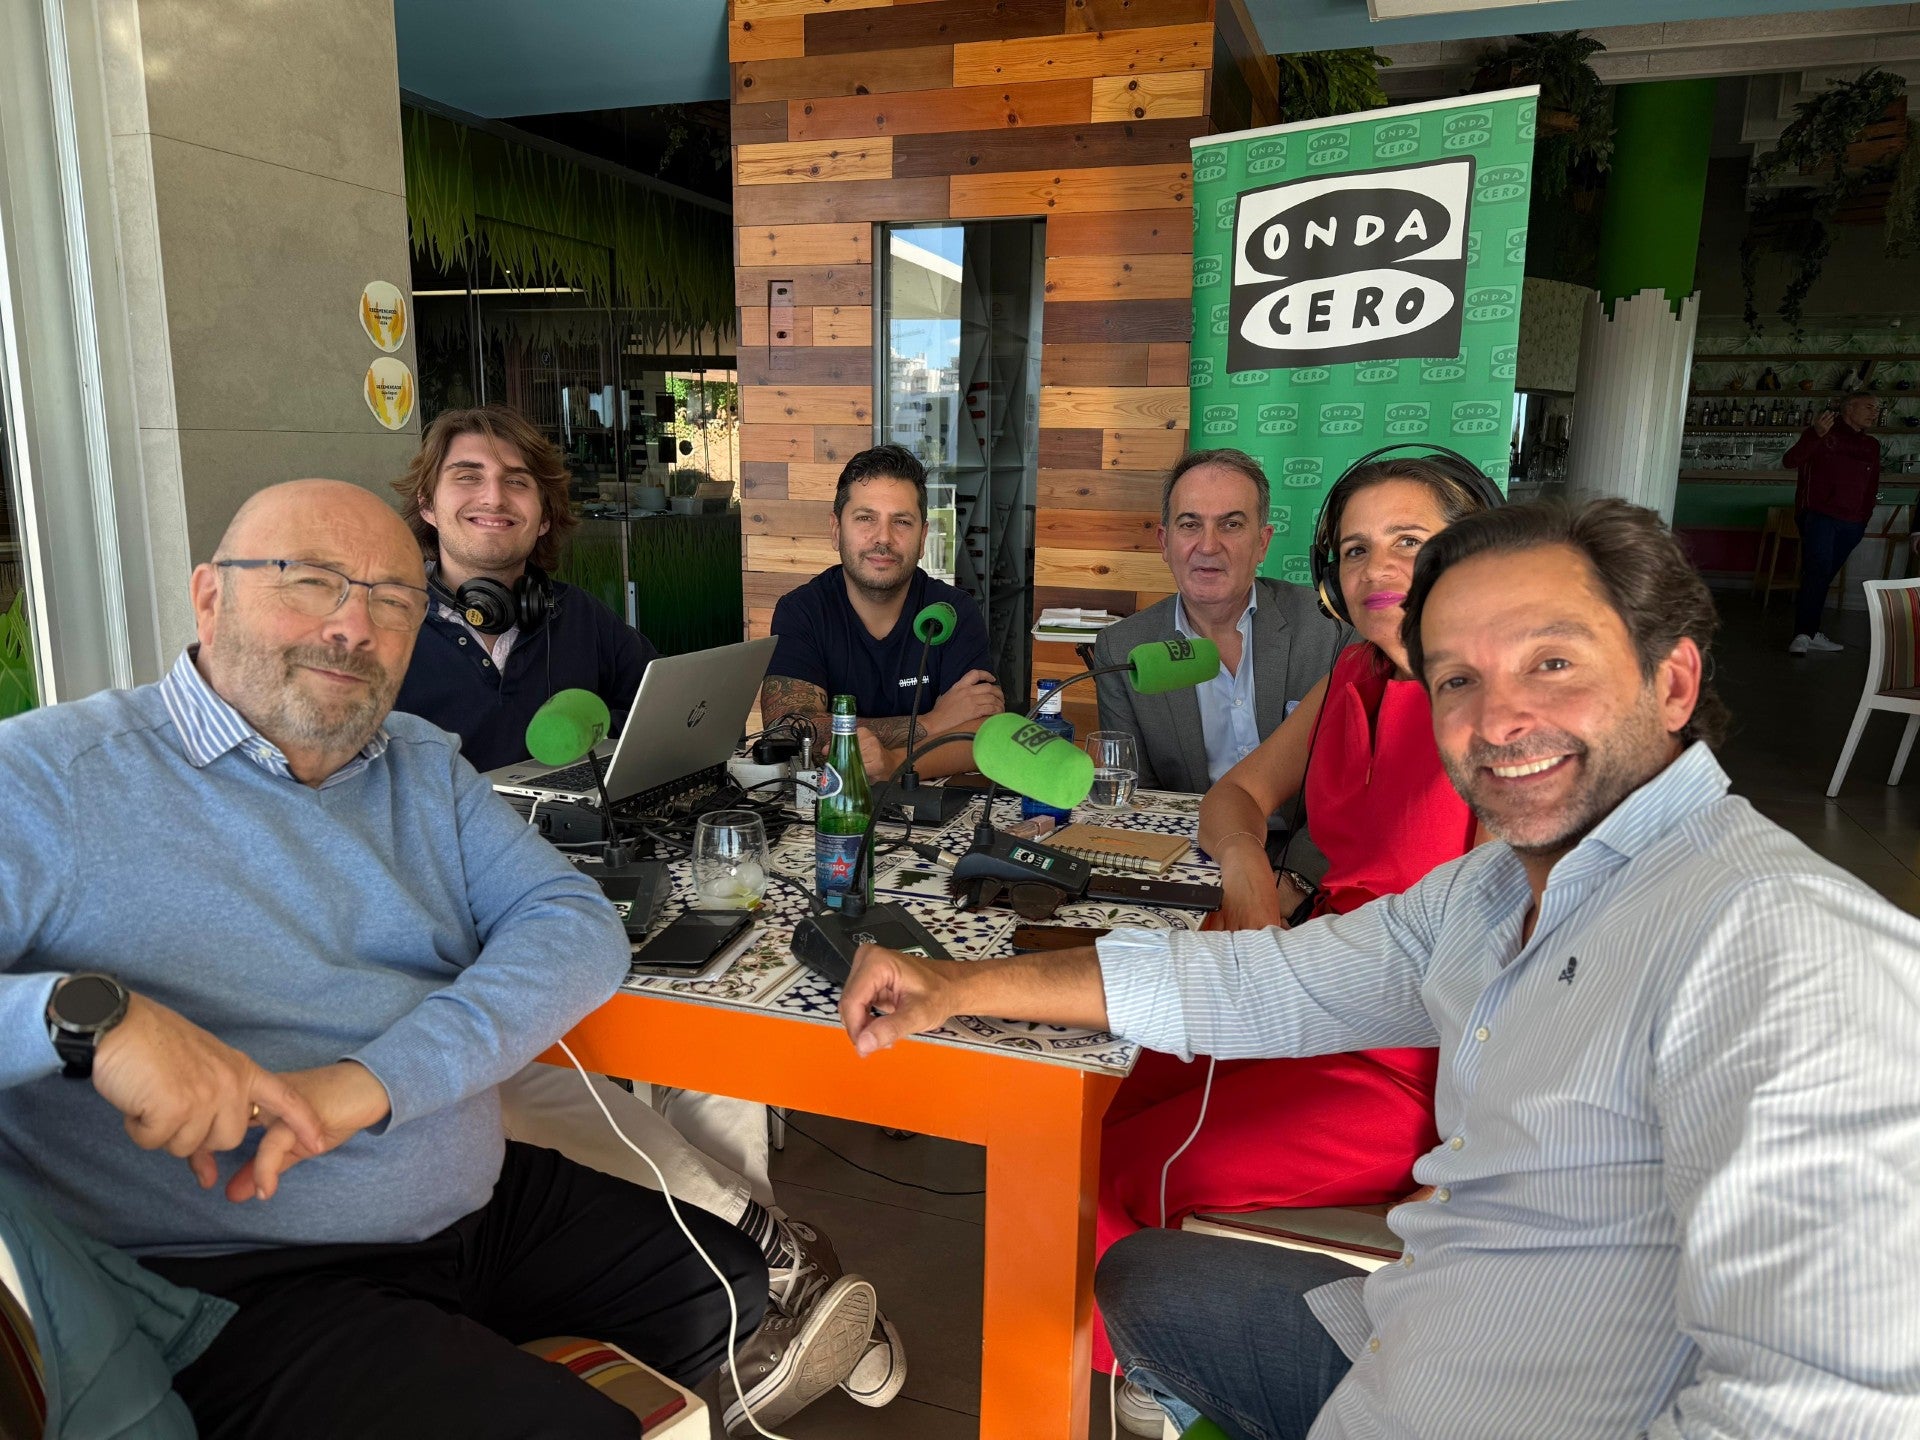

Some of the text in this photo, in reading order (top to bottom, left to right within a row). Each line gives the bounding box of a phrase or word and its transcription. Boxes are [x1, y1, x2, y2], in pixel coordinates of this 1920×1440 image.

[1450, 118, 1486, 131] ONDA
[1380, 128, 1414, 140] ONDA
[1312, 137, 1344, 148] ONDA
[1450, 133, 1484, 146] CERO
[1252, 145, 1281, 156] ONDA
[1381, 142, 1413, 155] CERO
[1196, 154, 1223, 165] ONDA
[1313, 150, 1343, 163] CERO
[1252, 160, 1281, 171] CERO
[1197, 169, 1222, 179] CERO
[1482, 172, 1520, 183] ONDA
[1483, 187, 1519, 199] CERO
[1222, 217, 1234, 226] CE
[1263, 208, 1428, 260] ONDA
[1472, 294, 1509, 302] ONDA
[1268, 286, 1425, 335] CERO
[1472, 307, 1507, 318] CERO
[1498, 352, 1516, 360] ON
[1297, 371, 1325, 380] CERO
[1362, 370, 1393, 379] CERO
[1428, 368, 1460, 378] CERO
[1499, 366, 1515, 376] CE
[1237, 373, 1265, 382] CERO
[1207, 410, 1234, 418] ONDA
[1263, 409, 1293, 418] ONDA
[1325, 409, 1358, 417] ONDA
[1390, 409, 1424, 417] ONDA
[1458, 407, 1494, 416] ONDA
[1207, 423, 1233, 431] CERO
[1264, 423, 1293, 431] CERO
[1326, 422, 1358, 431] CERO
[1391, 422, 1423, 431] CERO
[1459, 421, 1493, 430] CERO
[1487, 465, 1505, 474] ON
[1288, 476, 1317, 484] CERO
[1287, 558, 1309, 567] OND
[1288, 573, 1308, 581] CER
